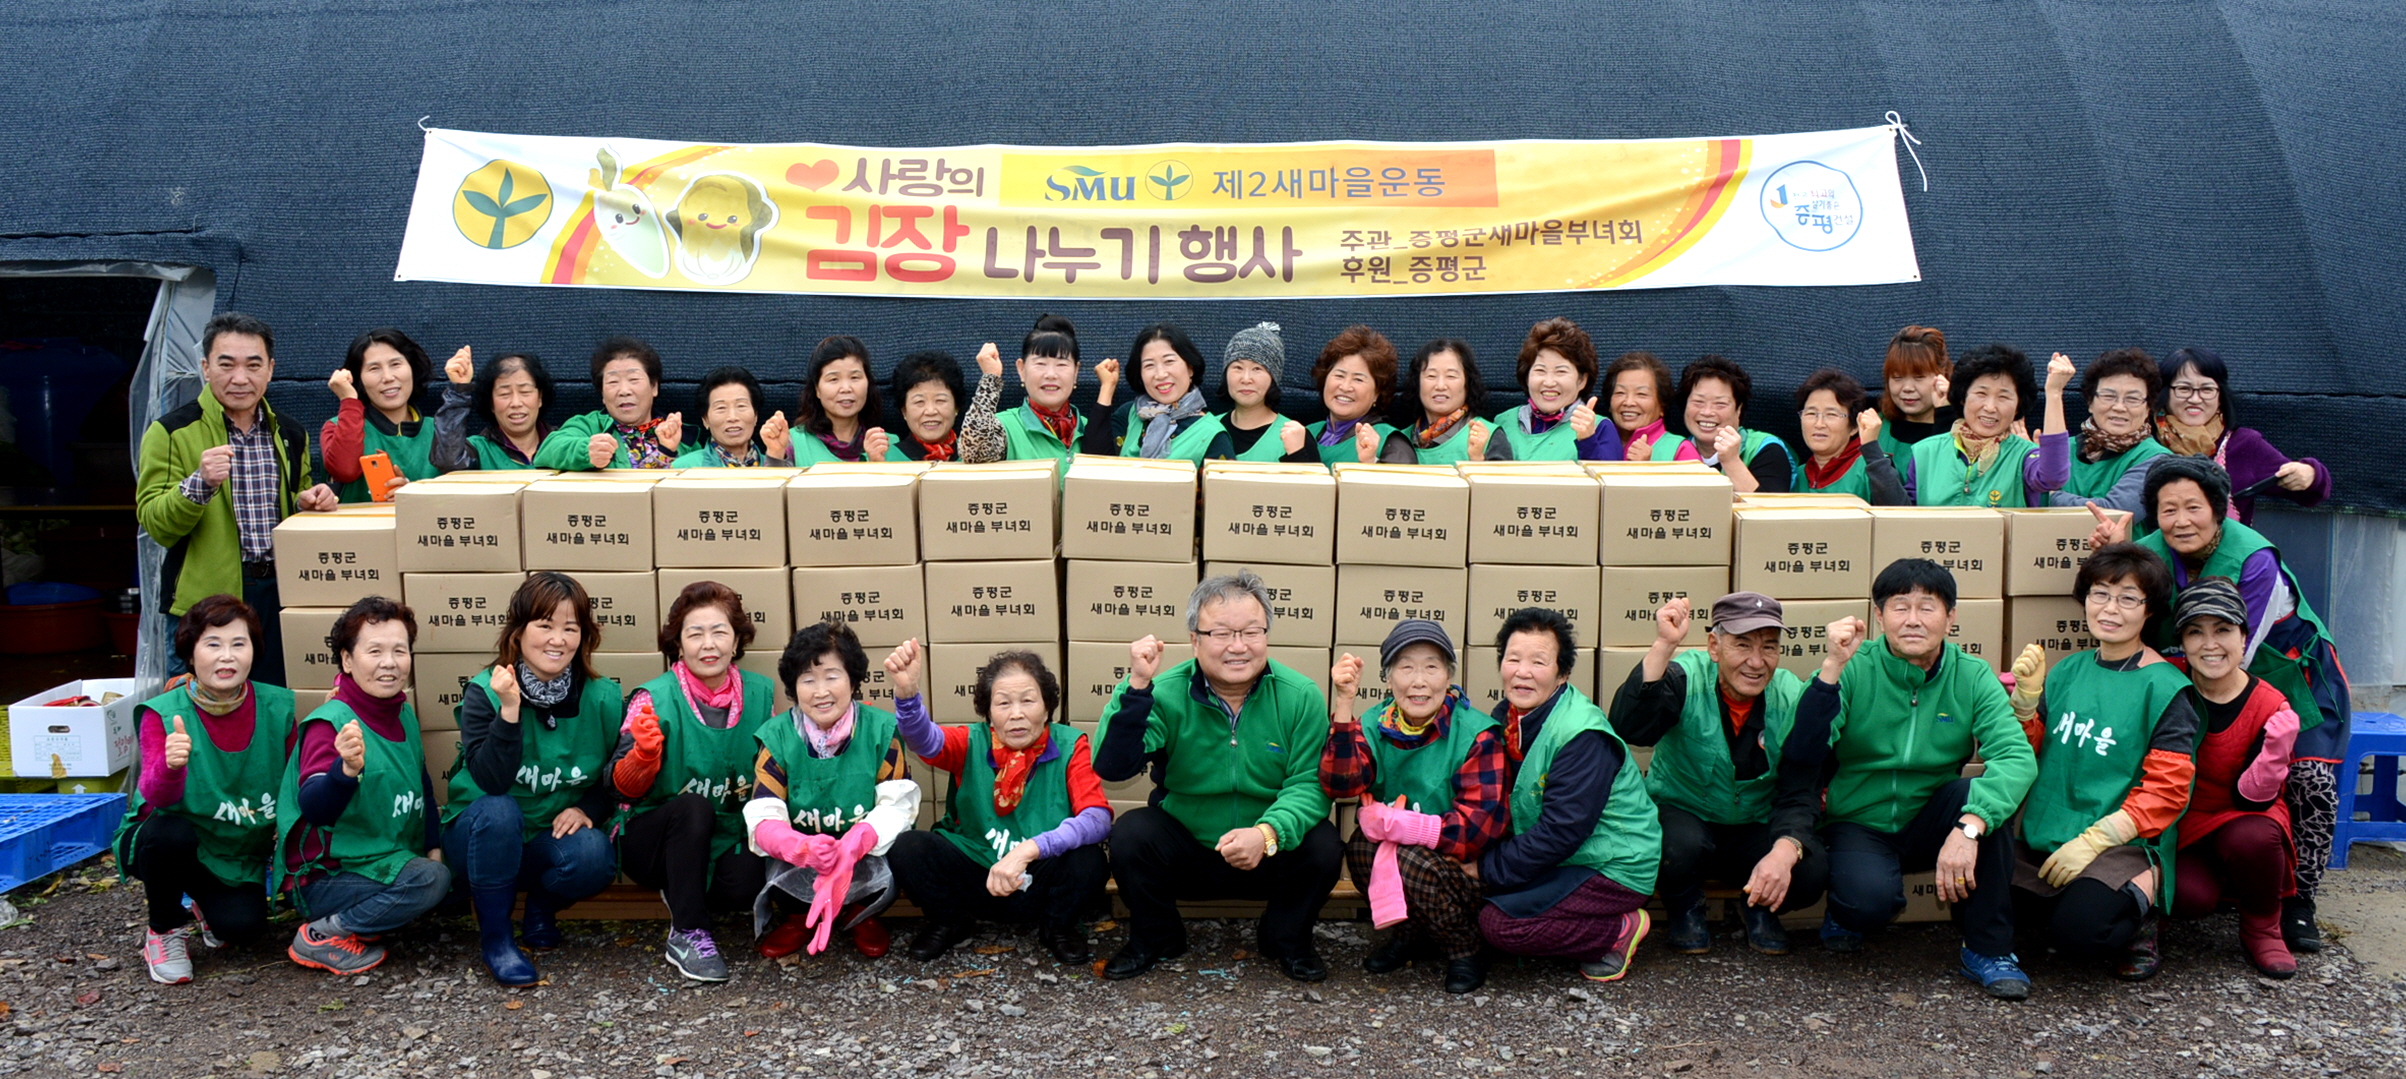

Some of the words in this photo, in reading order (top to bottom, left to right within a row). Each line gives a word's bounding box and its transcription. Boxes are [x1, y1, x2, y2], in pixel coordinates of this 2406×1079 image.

[843, 157, 985, 198] 사랑의
[1045, 165, 1136, 201] SMU
[1212, 165, 1446, 201] 제2새마을운동
[806, 204, 970, 283] 김장
[983, 225, 1162, 285] 나누기
[1178, 225, 1303, 284] 행사
[1341, 255, 1486, 285] 후원_증평군
[968, 503, 1007, 515] 증평군
[1110, 504, 1149, 516] 증평군
[1252, 505, 1292, 518] 증평군
[1386, 508, 1425, 521] 증평군
[1517, 507, 1556, 519] 증평군
[568, 515, 606, 527] 증평군
[699, 511, 738, 523] 증평군
[831, 510, 869, 523] 증평군
[1650, 510, 1689, 522] 증평군
[437, 518, 474, 529] 증평군
[946, 521, 985, 533] 새마을
[991, 520, 1030, 532] 부녀회
[1087, 521, 1126, 533] 새마을
[1132, 523, 1171, 535] 부녀회
[677, 529, 715, 541] 새마을
[722, 529, 760, 541] 부녀회
[810, 528, 847, 540] 새마을
[854, 527, 892, 539] 부녀회
[1229, 523, 1268, 535] 새마을
[1274, 525, 1313, 537] 부녀회
[1362, 526, 1401, 539] 새마을
[1407, 528, 1446, 540] 부녀회
[1493, 525, 1533, 537] 새마을
[1539, 526, 1578, 537] 부녀회
[1627, 527, 1666, 539] 새마을
[1672, 527, 1711, 539] 부녀회
[418, 535, 454, 547] 새마을
[460, 535, 498, 547] 부녀회
[547, 532, 584, 544] 새마을
[591, 533, 628, 545] 부녀회
[1788, 543, 1827, 555] 증평군
[1921, 541, 1960, 553] 증평군
[319, 552, 356, 564] 증평군
[2034, 556, 2071, 569] 새마을
[1764, 560, 1804, 572] 새마을
[1810, 560, 1849, 572] 부녀회
[1942, 559, 1982, 573] 부녀회
[299, 569, 335, 581] 새마을
[341, 569, 379, 581] 부녀회
[973, 587, 1011, 599] 증평군
[1114, 586, 1152, 598] 증평군
[1267, 588, 1292, 600] 평군
[1384, 590, 1423, 603] 증평군
[1517, 590, 1556, 602] 증평군
[449, 597, 486, 609] 증평군
[589, 597, 613, 609] 평군
[841, 592, 880, 605] 증평군
[820, 611, 859, 623] 새마을
[865, 608, 903, 621] 부녀회
[951, 604, 990, 616] 새마을
[996, 604, 1035, 616] 부녀회
[1091, 603, 1129, 615] 새마을
[1136, 605, 1174, 616] 부녀회
[1274, 607, 1313, 619] 부녀회
[1360, 607, 1399, 620] 새마을
[1406, 609, 1445, 621] 부녀회
[429, 615, 466, 626] 새마을
[597, 615, 636, 627] 부녀회
[1788, 626, 1826, 638] 증평군
[1779, 645, 1802, 657] 마을
[2053, 711, 2117, 756] 새마을
[515, 765, 588, 793] 새마을
[678, 774, 753, 804] 새마을
[213, 792, 276, 825] 새마을
